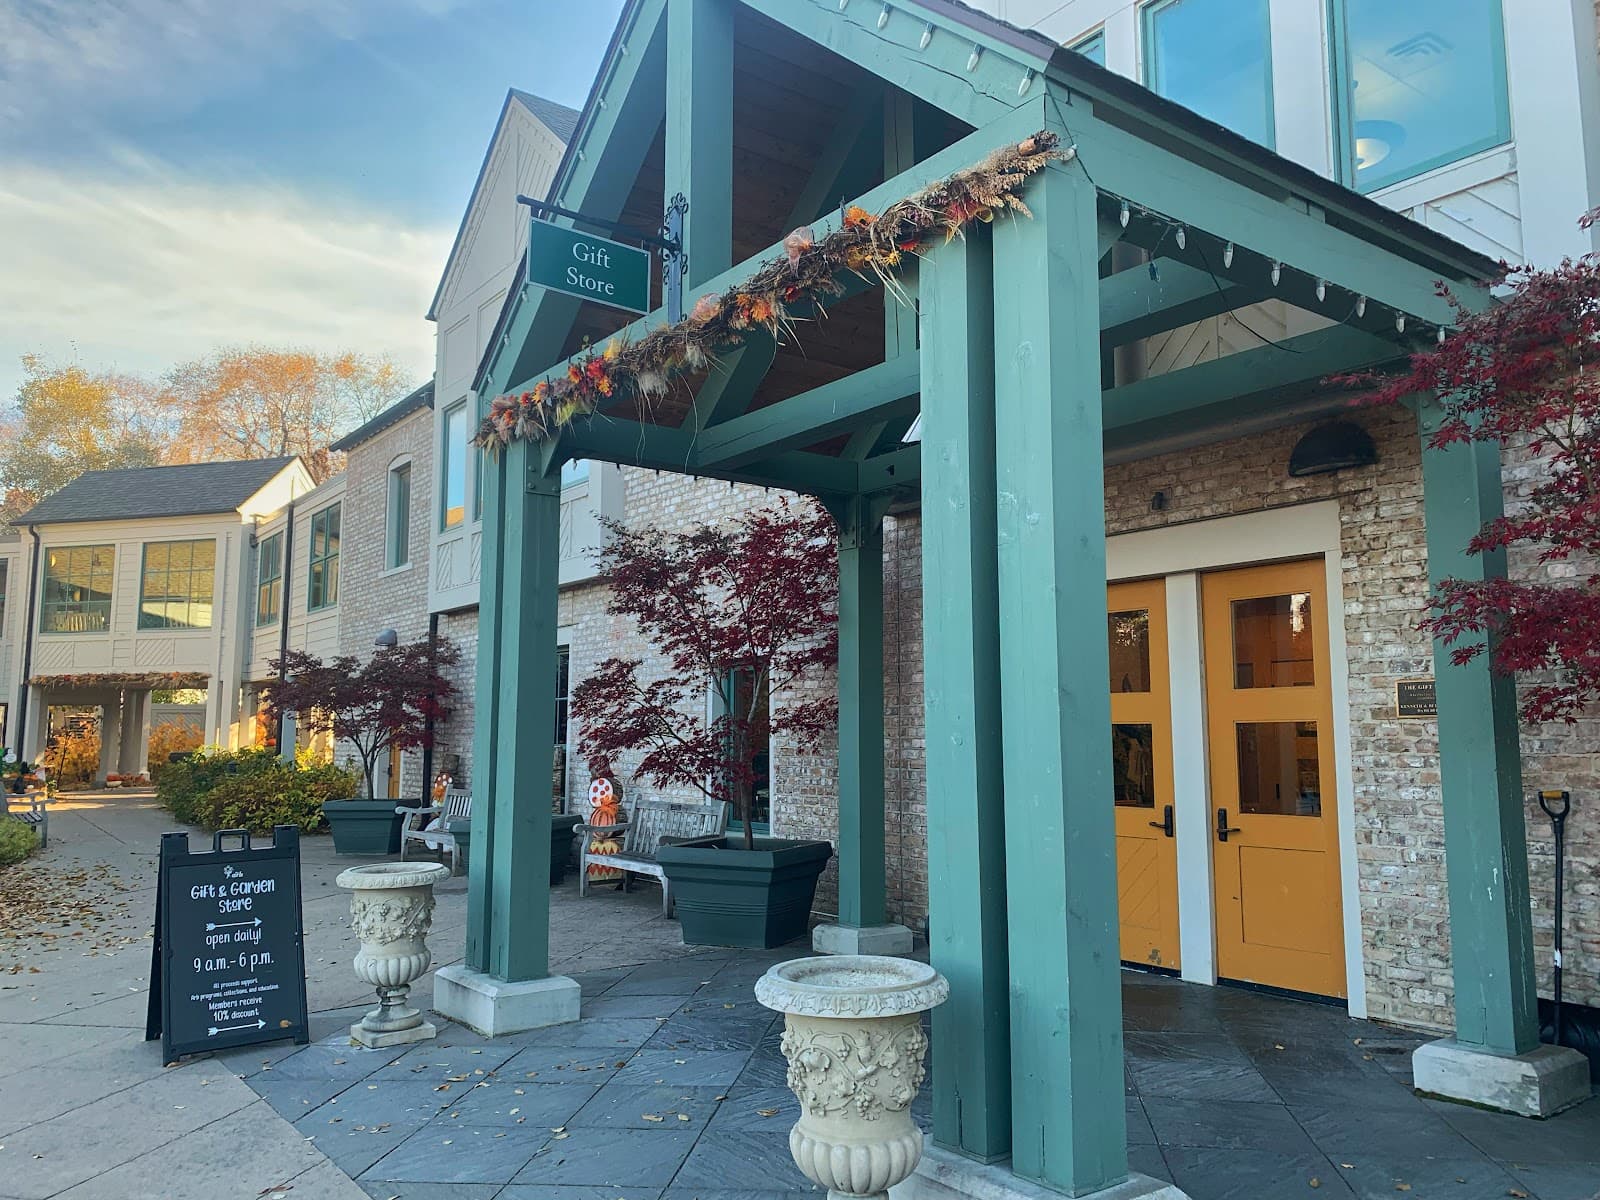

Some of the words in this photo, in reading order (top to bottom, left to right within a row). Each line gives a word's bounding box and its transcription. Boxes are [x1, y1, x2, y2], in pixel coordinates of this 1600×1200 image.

[572, 242, 611, 269] Gift
[566, 266, 615, 296] Store
[218, 885, 228, 898] &
[230, 879, 275, 896] Garden
[218, 897, 253, 914] Store
[205, 933, 231, 950] open
[193, 957, 201, 973] 9
[239, 951, 247, 968] 6
[250, 951, 275, 973] p.m.
[208, 999, 238, 1011] Members
[239, 996, 263, 1007] receive
[213, 1009, 230, 1022] 10%
[230, 1007, 260, 1020] discount
